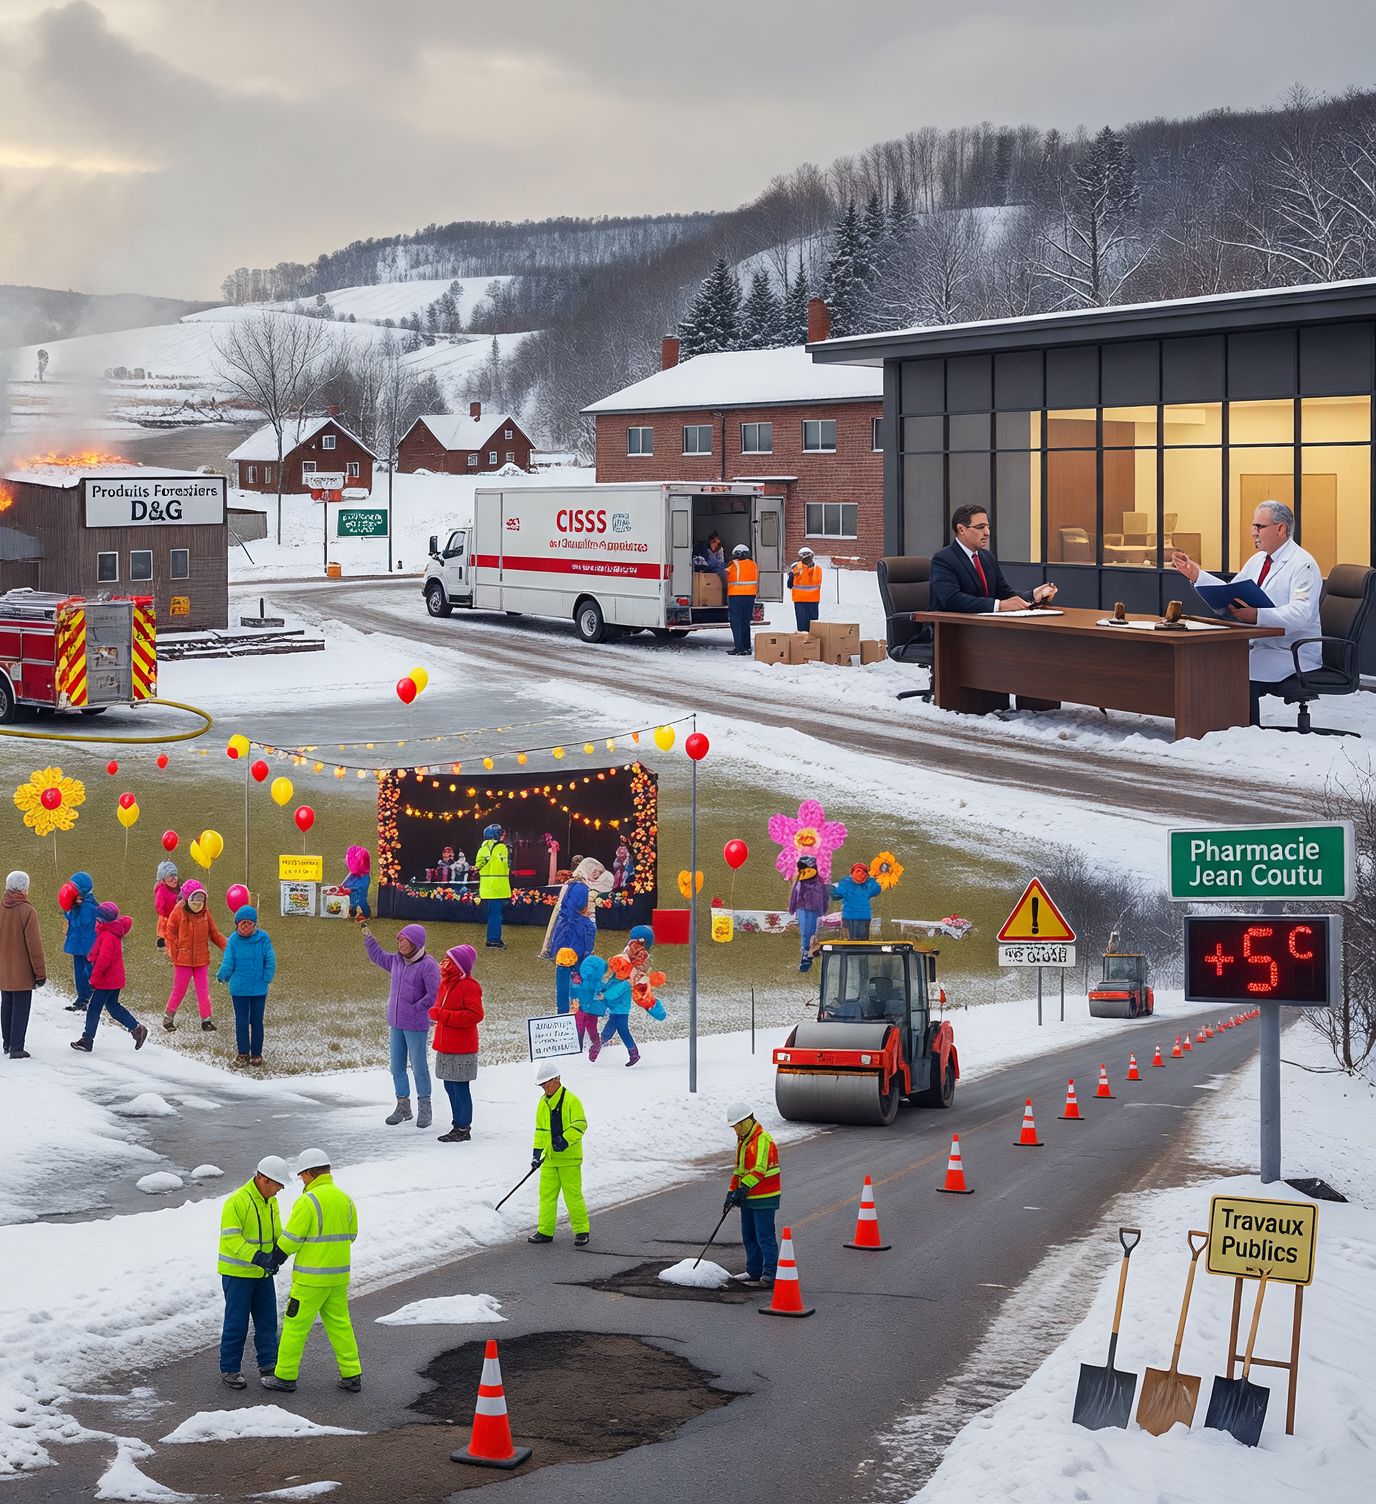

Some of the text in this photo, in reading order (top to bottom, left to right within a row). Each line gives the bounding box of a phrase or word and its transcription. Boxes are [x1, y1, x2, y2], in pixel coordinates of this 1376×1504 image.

[130, 500, 183, 521] D&G
[556, 509, 607, 534] CISSS
[1190, 836, 1320, 862] Pharmacie
[1189, 864, 1323, 886] Jean Coutu
[1221, 1207, 1305, 1236] Travaux
[1221, 1235, 1298, 1264] Publics
